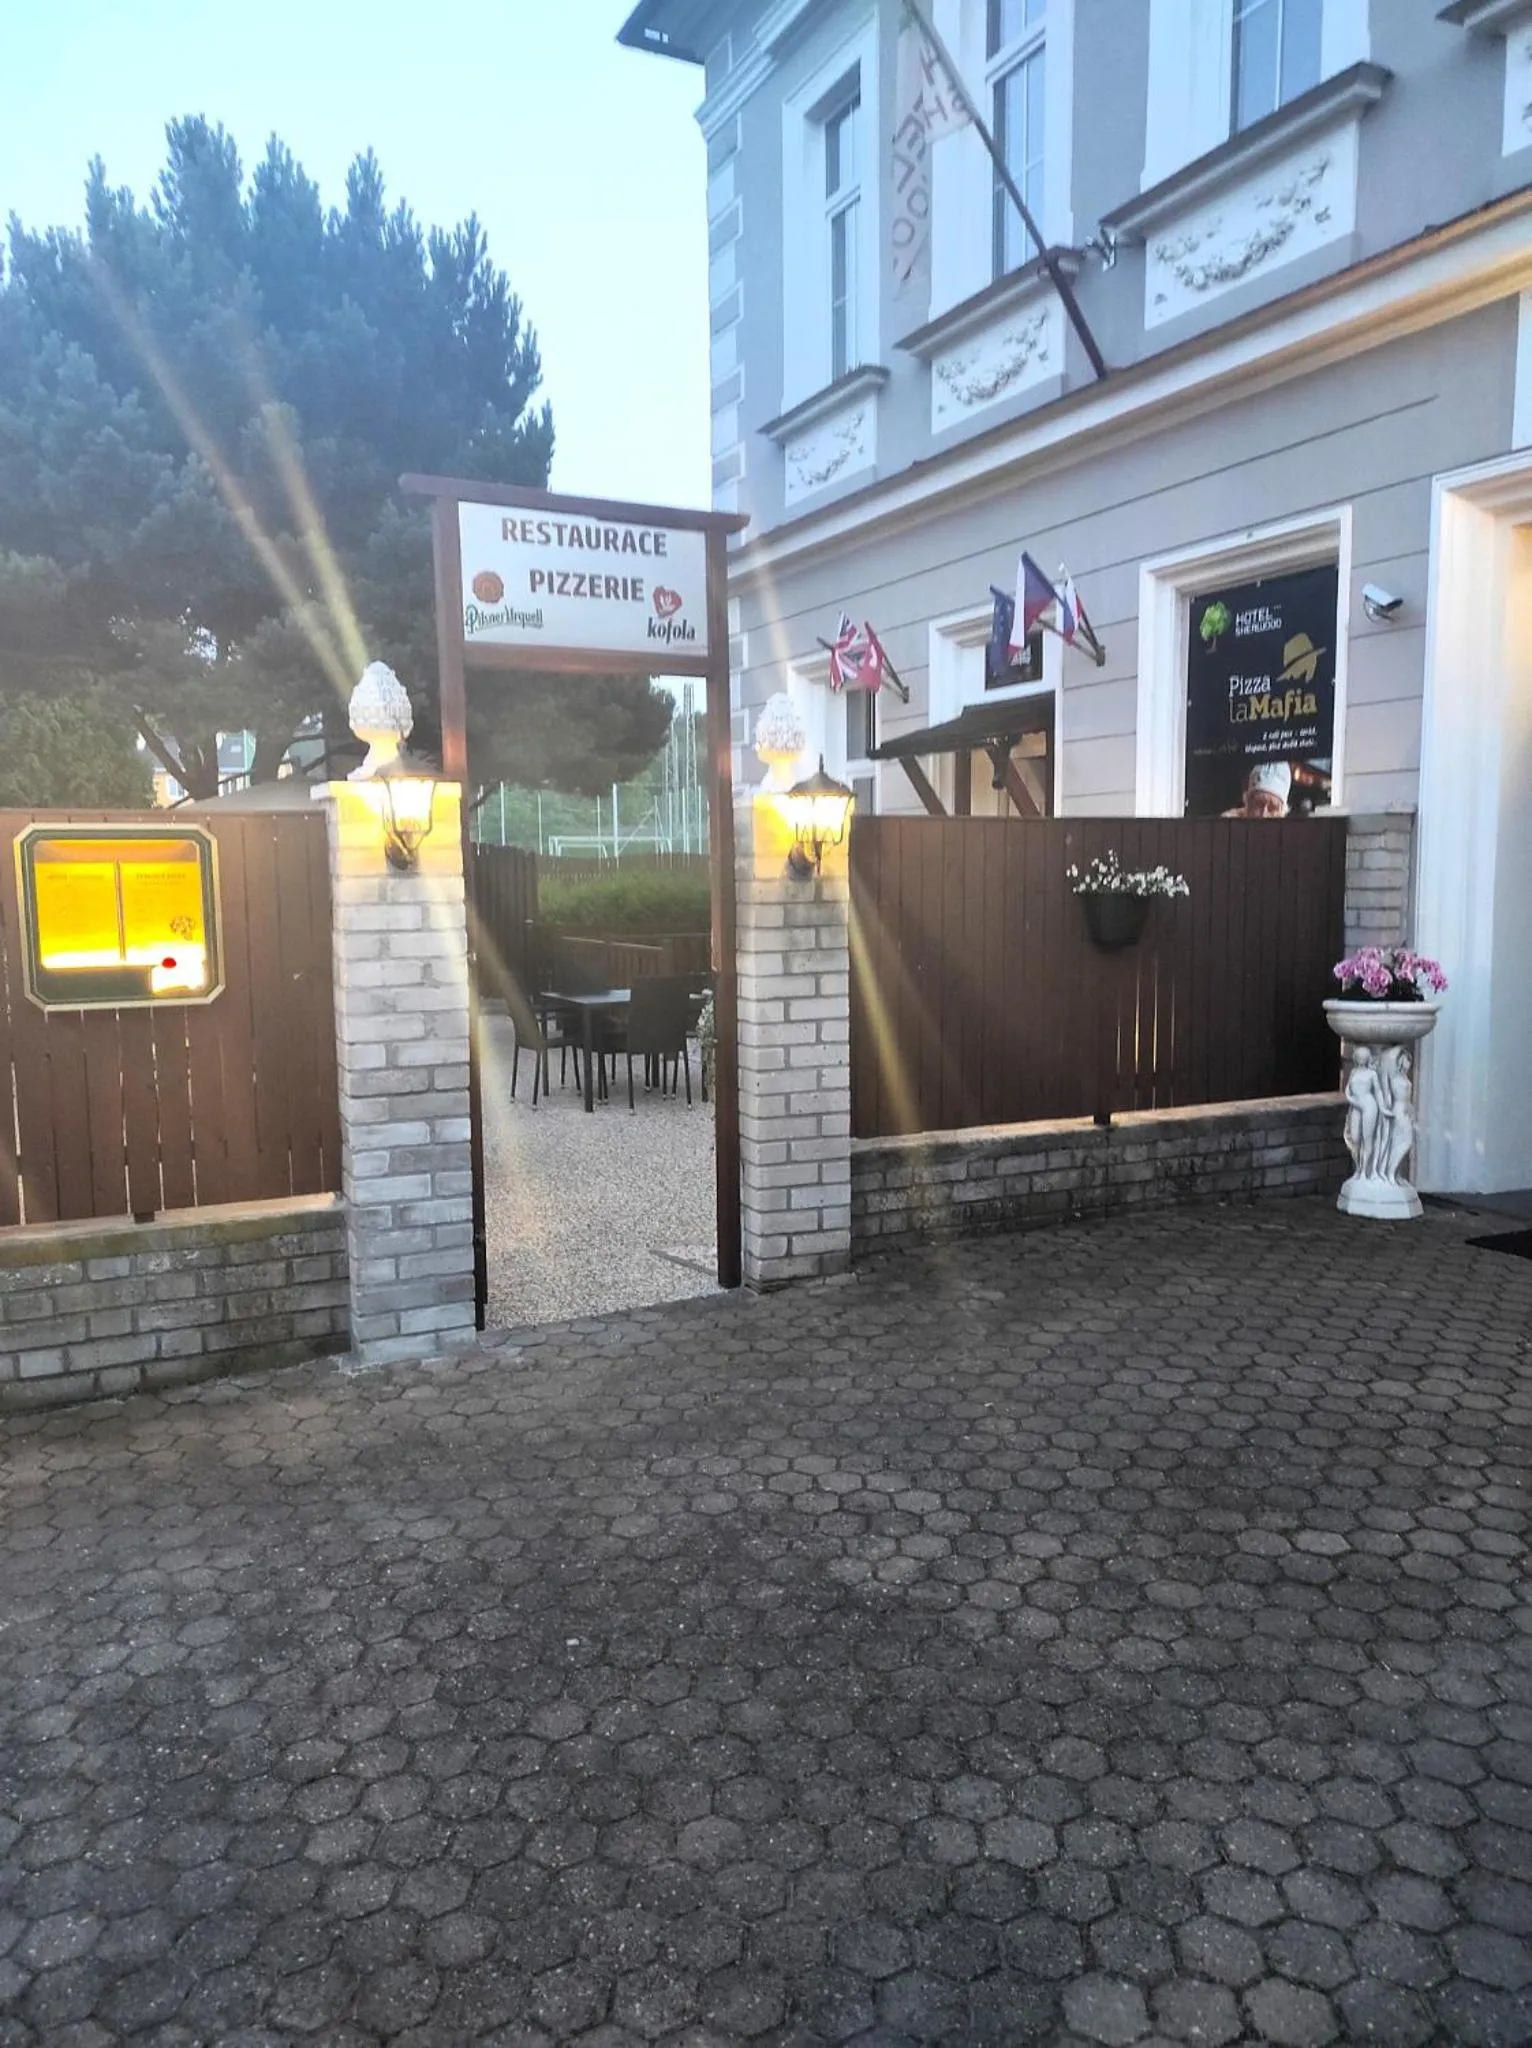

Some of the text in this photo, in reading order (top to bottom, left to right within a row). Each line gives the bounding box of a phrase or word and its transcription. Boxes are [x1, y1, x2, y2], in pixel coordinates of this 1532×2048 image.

[502, 518, 668, 558] RESTAURACE
[529, 569, 645, 602] PIZZERIE
[647, 616, 696, 645] kofola
[1235, 606, 1273, 626] HOTEL
[1229, 675, 1271, 698] Pizza
